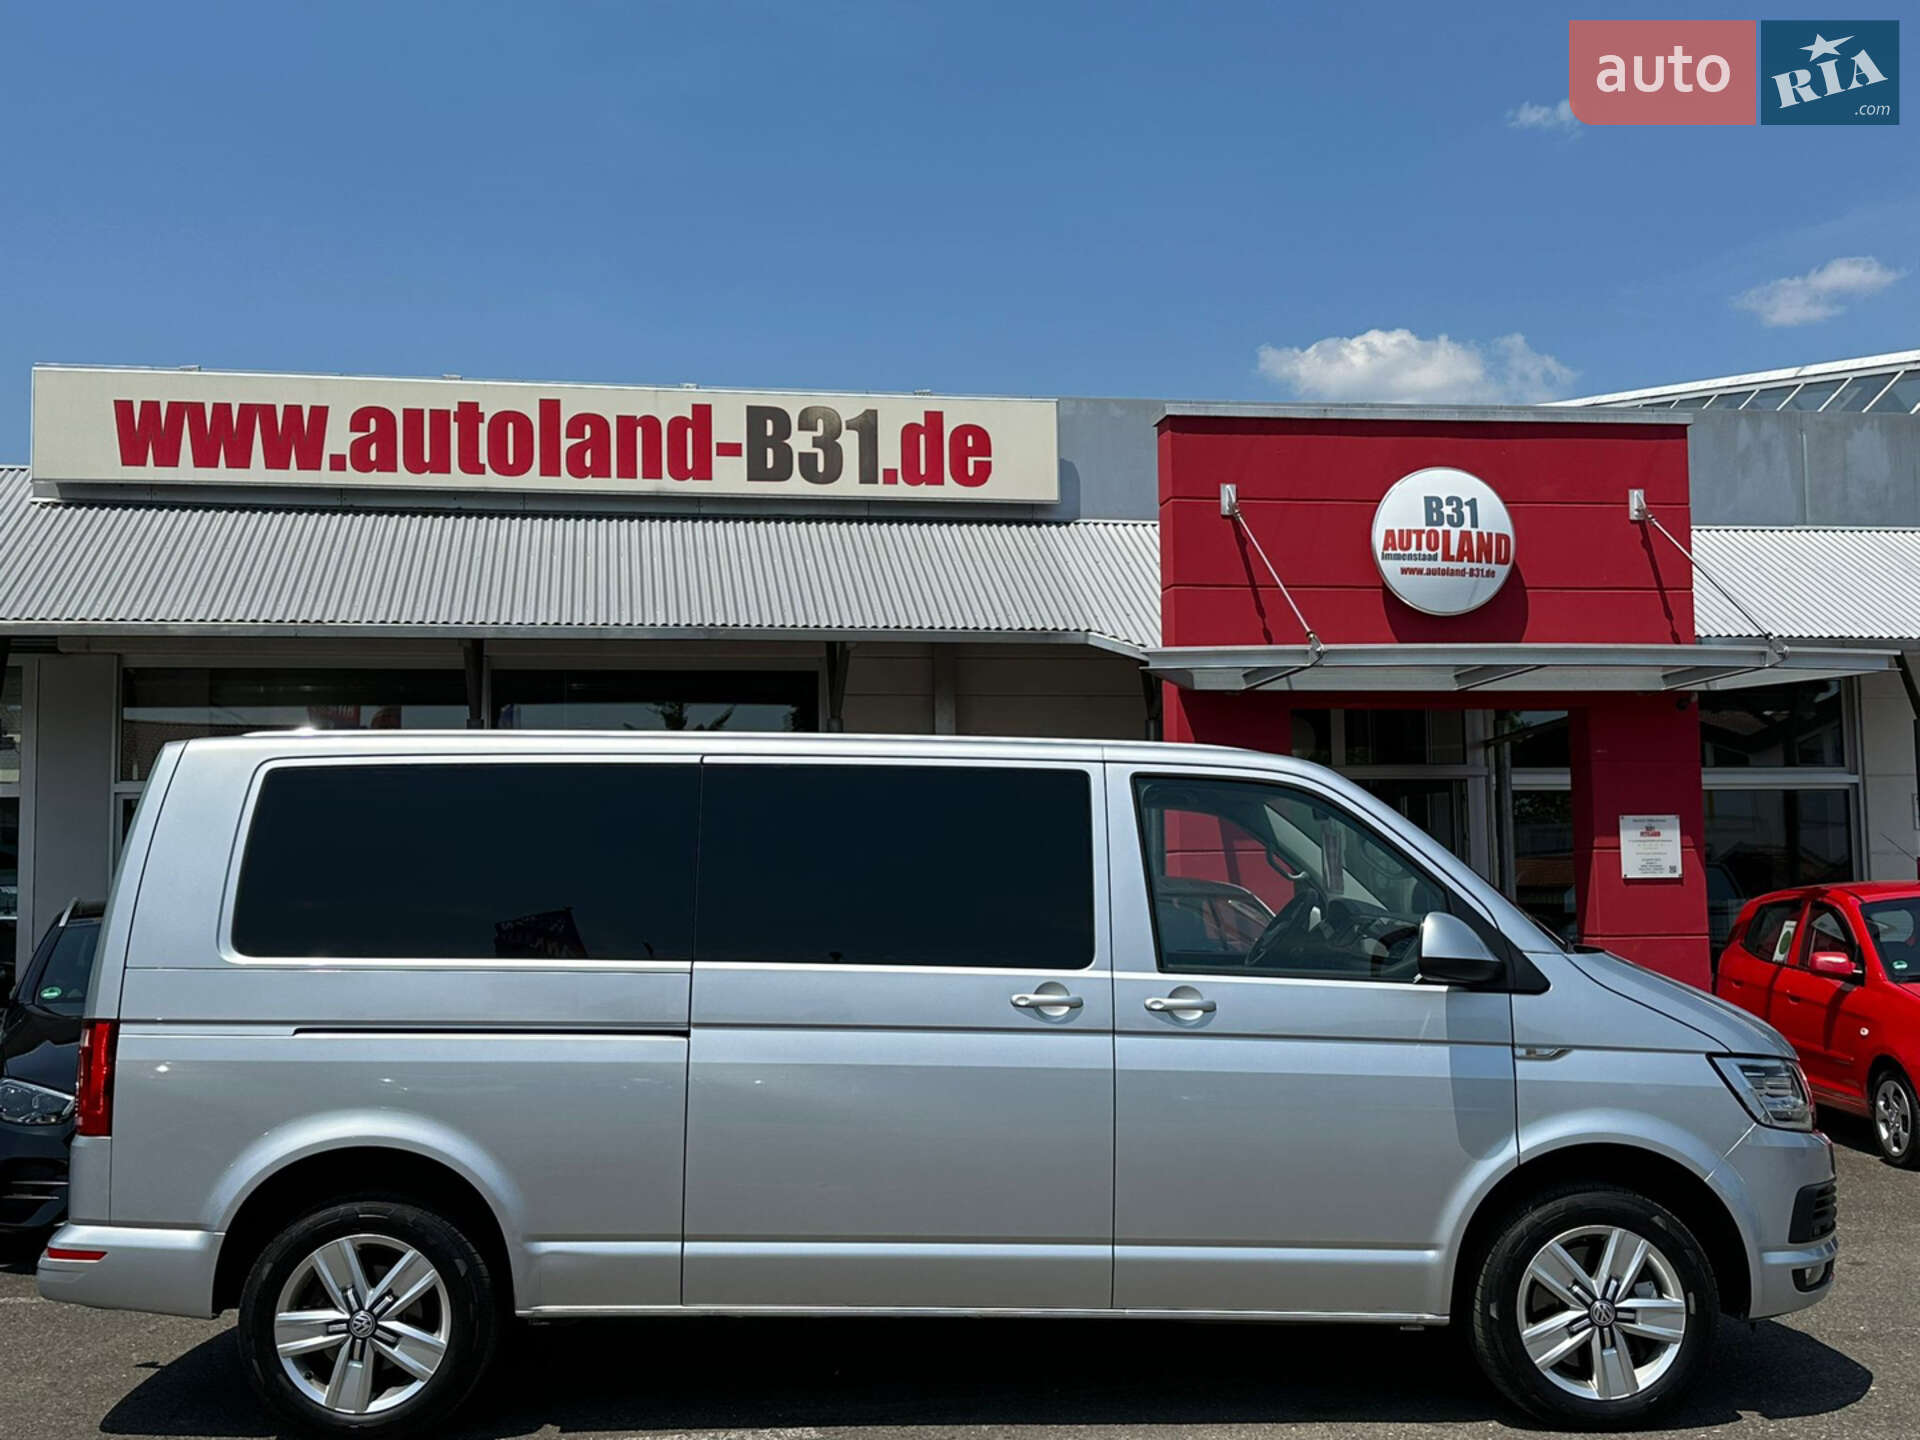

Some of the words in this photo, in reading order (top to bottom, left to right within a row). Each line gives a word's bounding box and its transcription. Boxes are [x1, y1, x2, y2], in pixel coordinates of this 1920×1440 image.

[113, 398, 992, 488] www.autoland-B31.de
[1423, 495, 1479, 529] B31
[1381, 551, 1438, 562] Immenstaad
[1400, 566, 1496, 579] www.autoland-B31.de
